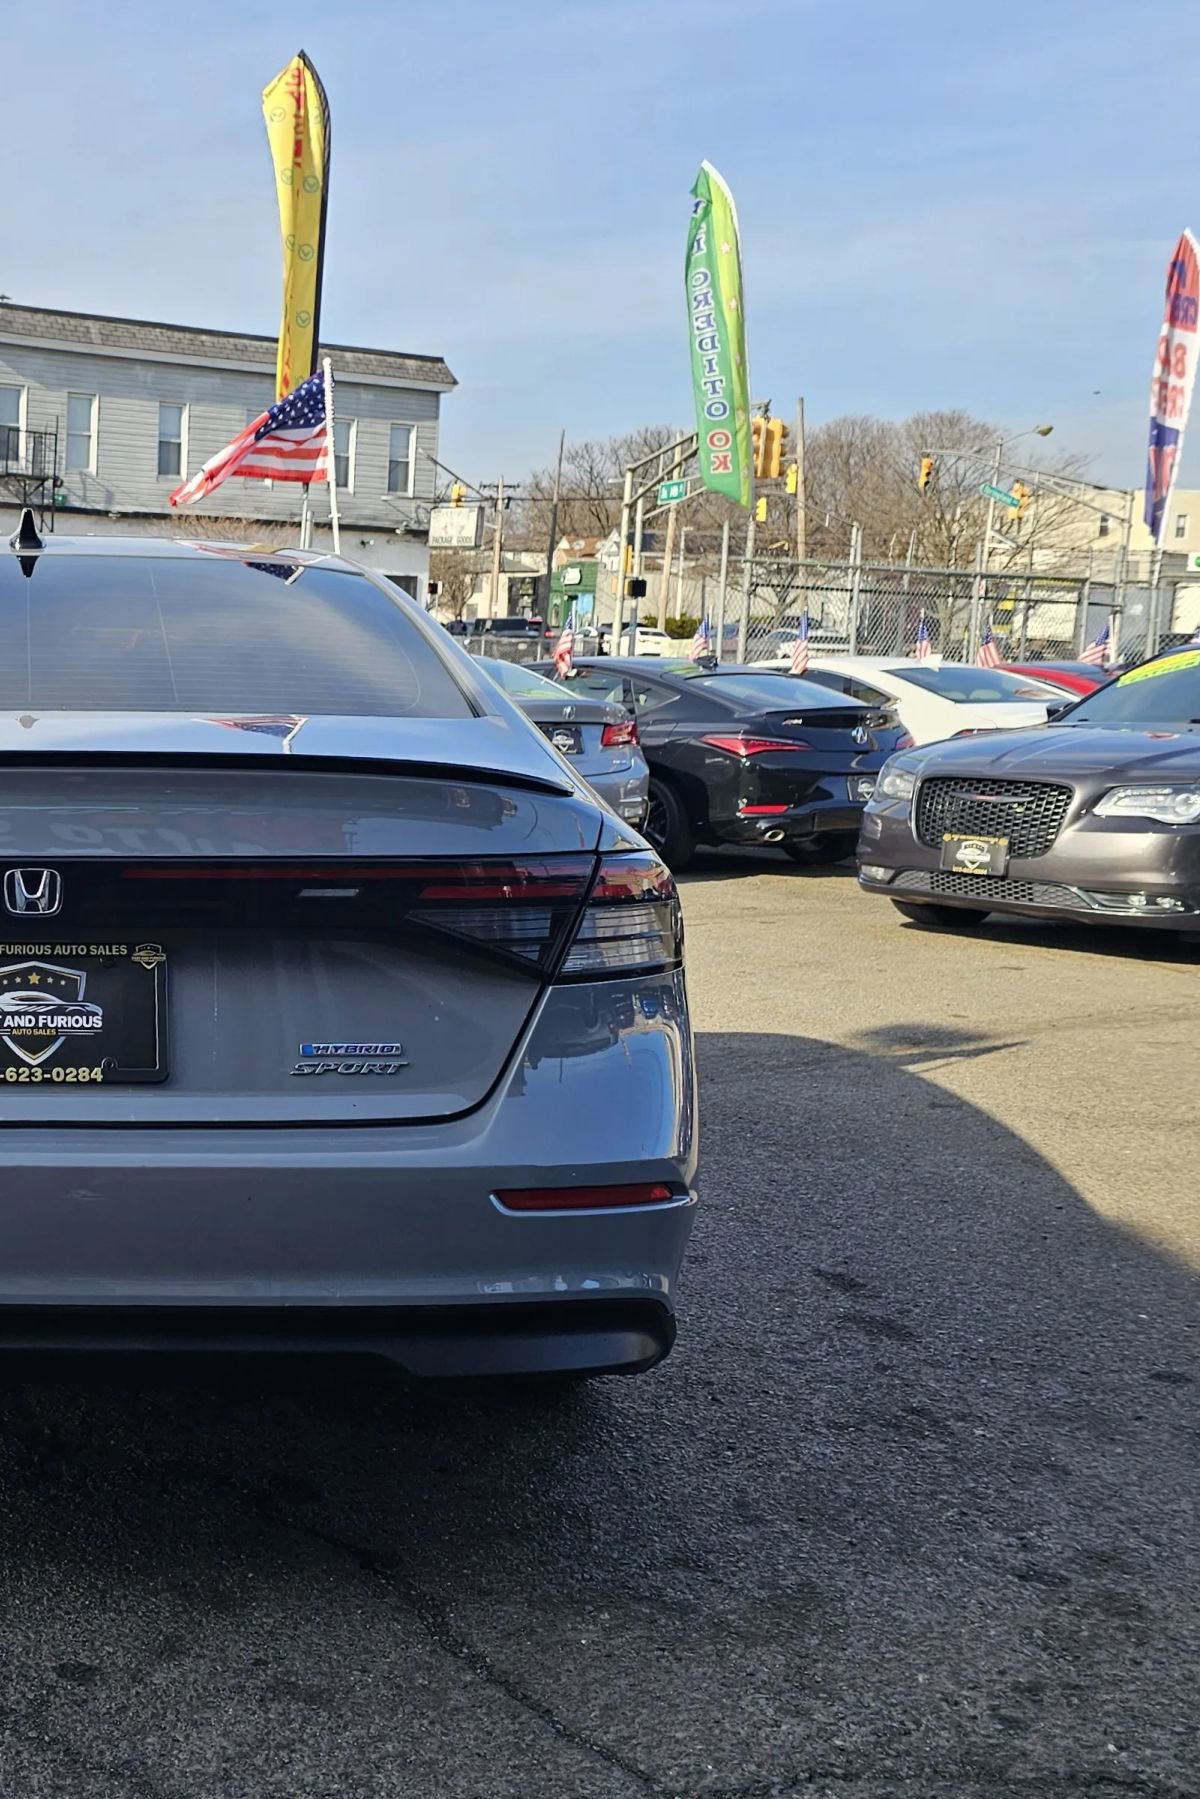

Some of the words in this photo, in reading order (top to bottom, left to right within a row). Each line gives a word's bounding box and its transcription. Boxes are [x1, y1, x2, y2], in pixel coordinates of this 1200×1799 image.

[0, 944, 51, 955] FURIOUS
[54, 945, 87, 955] AUTO
[89, 945, 128, 955] SALES
[3, 1015, 36, 1028] AND
[38, 1015, 103, 1028] FURIOUS
[12, 1028, 31, 1036] AUTO
[33, 1028, 57, 1036] SALES
[312, 1044, 400, 1055] HYBRID
[289, 1061, 409, 1075] SPORT
